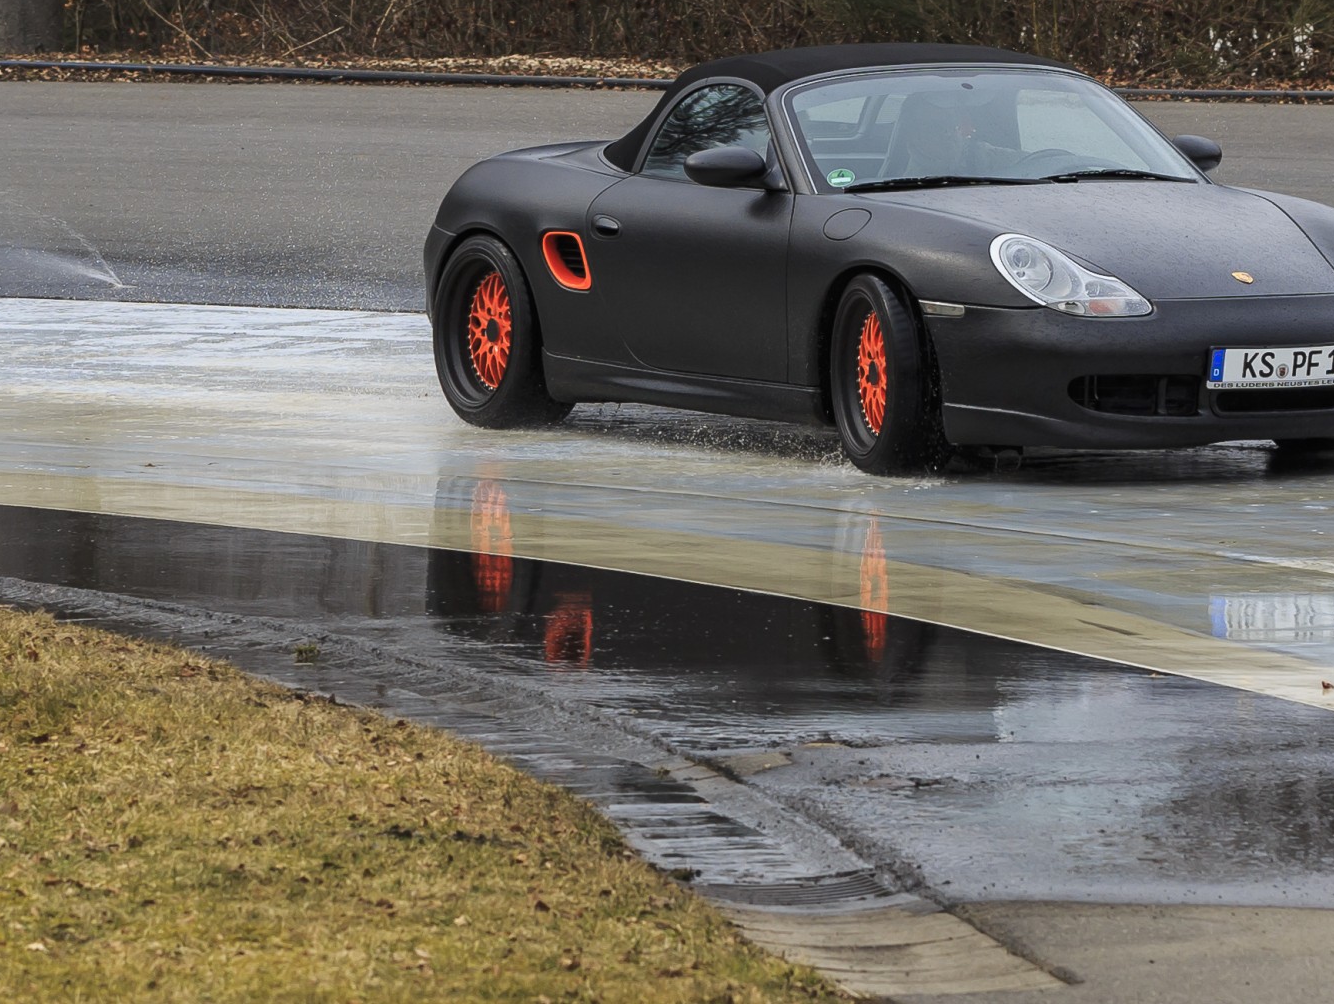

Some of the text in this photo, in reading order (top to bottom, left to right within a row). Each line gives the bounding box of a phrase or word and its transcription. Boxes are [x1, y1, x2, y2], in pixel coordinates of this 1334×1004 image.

[1213, 368, 1220, 377] D
[1242, 352, 1275, 378] KS
[1292, 350, 1322, 376] PF
